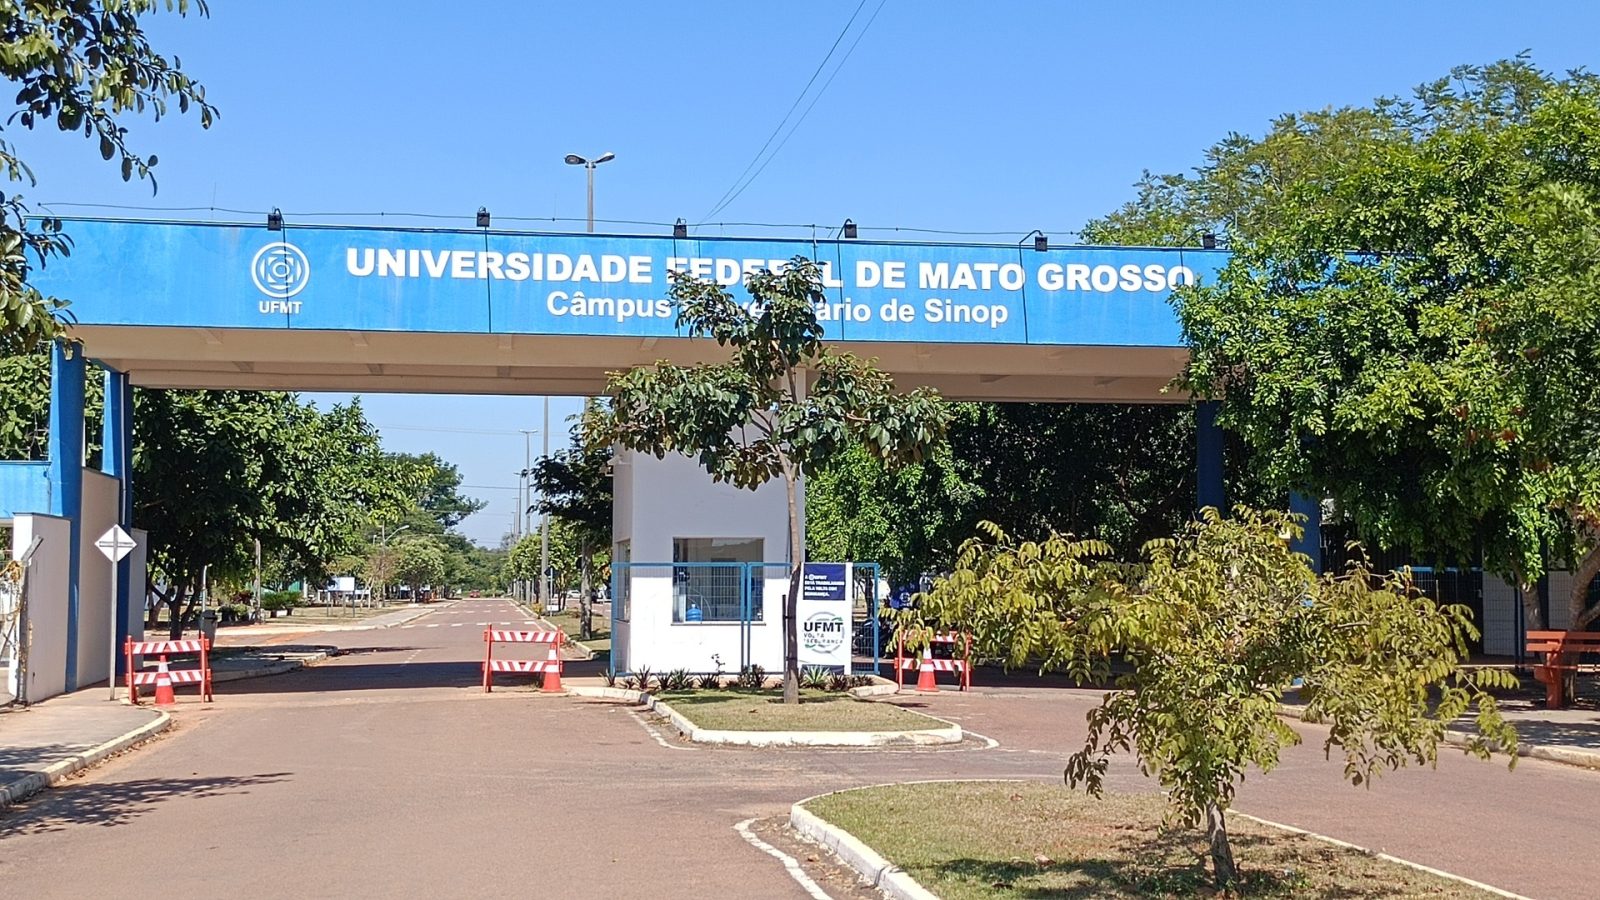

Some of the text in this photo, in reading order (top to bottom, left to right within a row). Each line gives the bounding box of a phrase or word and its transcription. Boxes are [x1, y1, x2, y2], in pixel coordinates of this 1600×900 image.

[346, 248, 653, 284] UNIVERSIDADE
[855, 261, 906, 289] DE
[918, 262, 1025, 291] MATO
[1037, 264, 1194, 293] GROSSO
[259, 300, 303, 314] UFMT
[546, 290, 672, 322] Câmpus
[879, 298, 915, 323] de
[924, 298, 1009, 328] Sinop
[804, 621, 843, 632] UFMT
